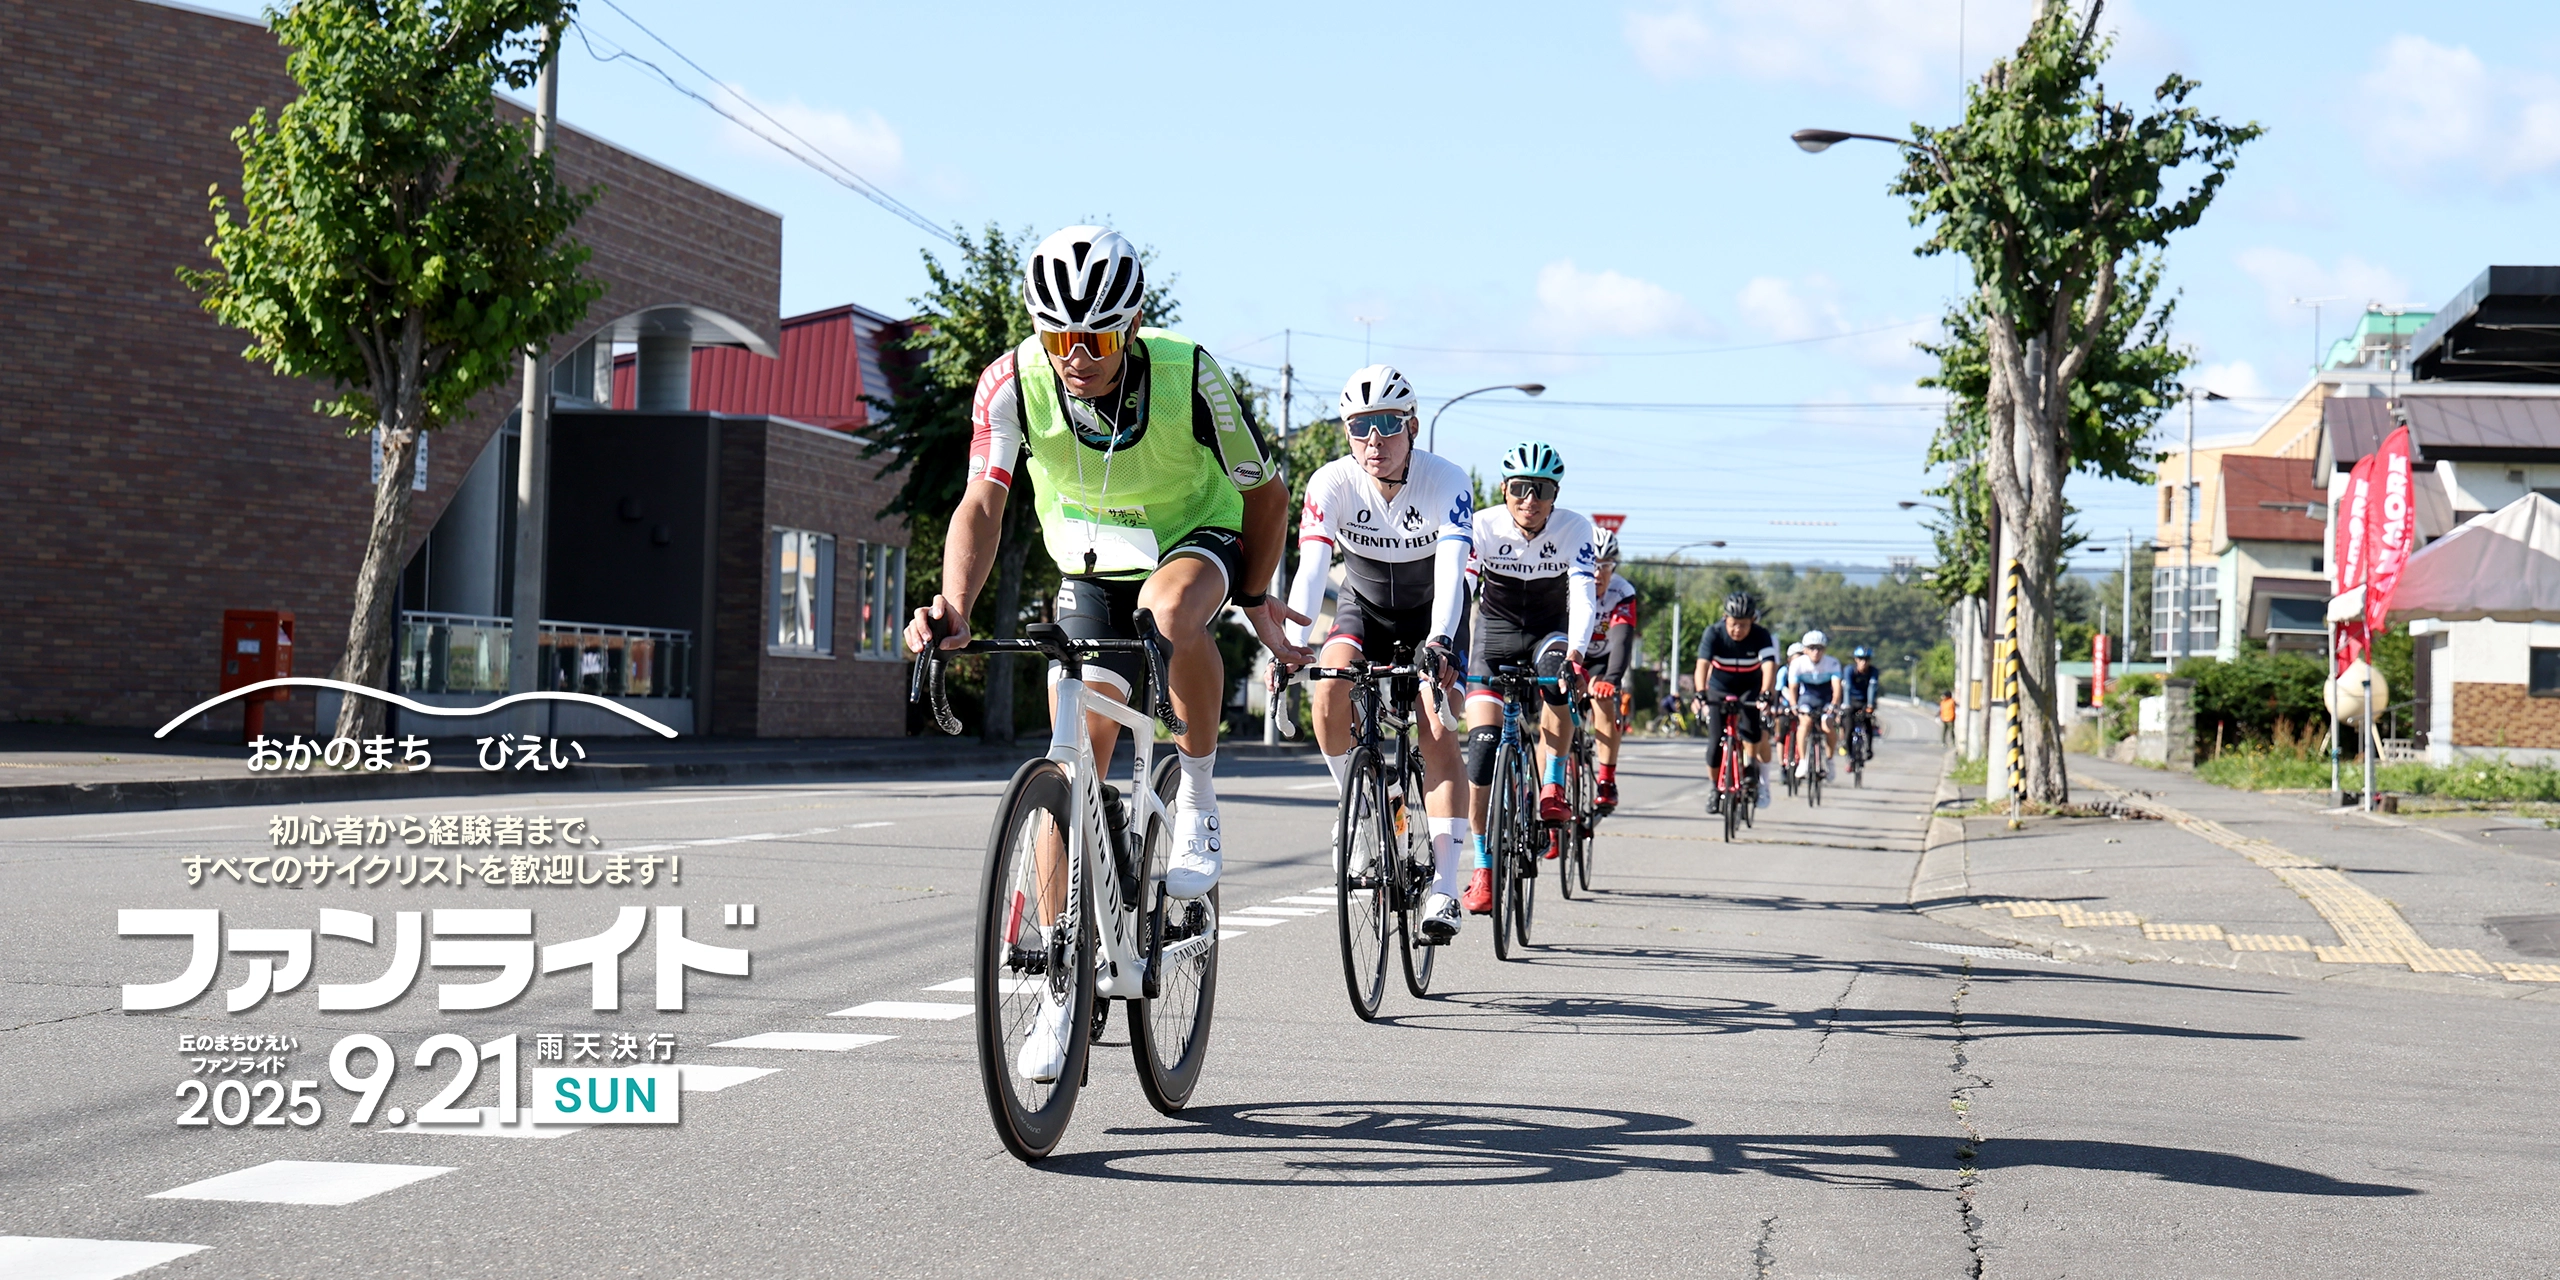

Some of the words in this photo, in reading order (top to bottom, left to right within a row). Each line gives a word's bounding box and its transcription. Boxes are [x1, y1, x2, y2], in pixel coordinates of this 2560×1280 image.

[1108, 508, 1143, 519] サポート
[1339, 527, 1401, 549] ETERNITY
[1173, 937, 1209, 964] CANYON
